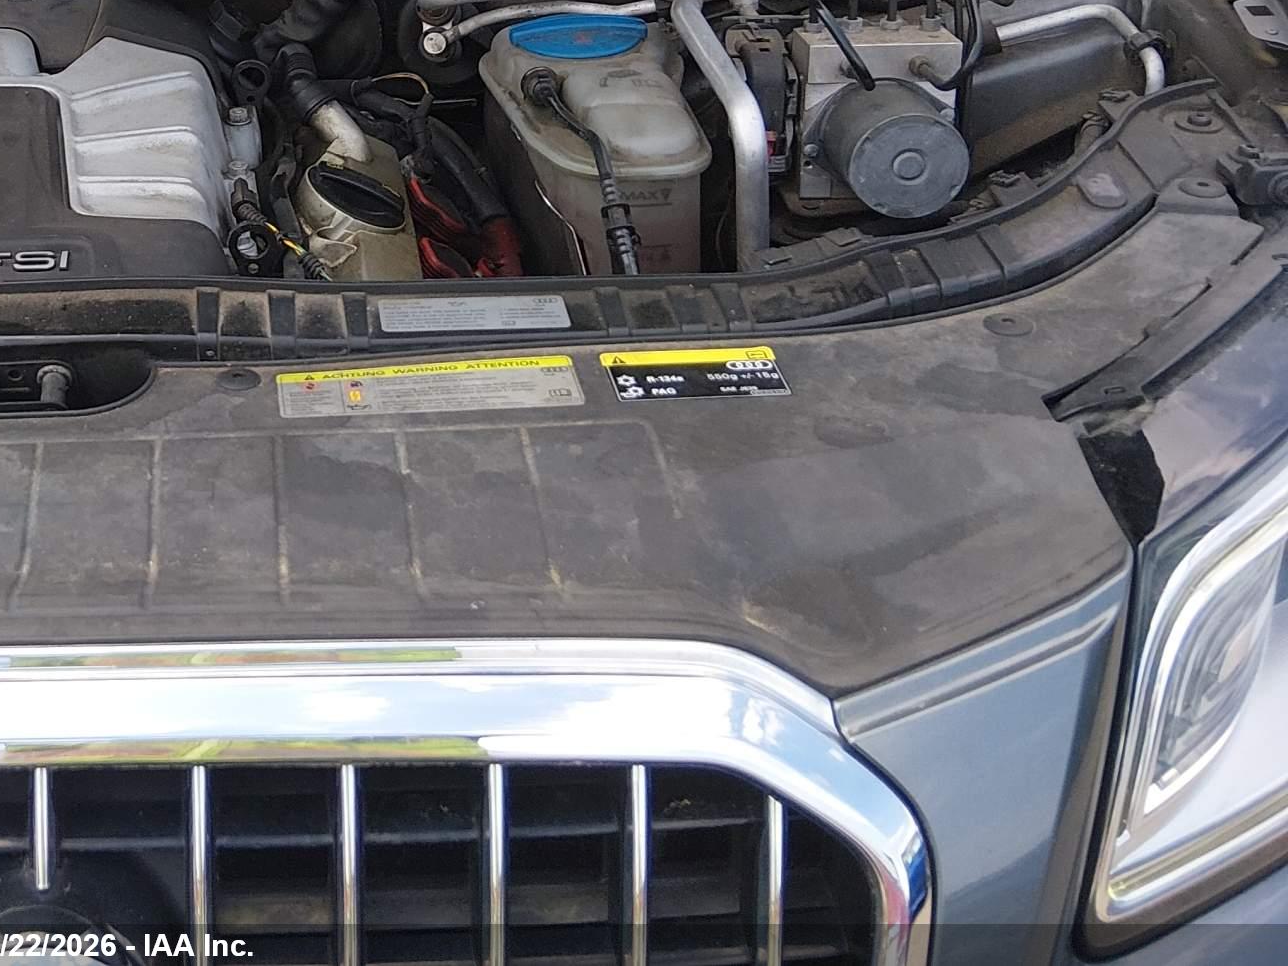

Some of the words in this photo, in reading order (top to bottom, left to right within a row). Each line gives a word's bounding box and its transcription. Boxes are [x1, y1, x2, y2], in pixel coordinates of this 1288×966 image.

[322, 370, 385, 380] ACHTUNG
[392, 364, 458, 374] WARNING
[466, 359, 540, 370] ATTENTION
[706, 373, 738, 382] 550g
[652, 388, 677, 396] PAG
